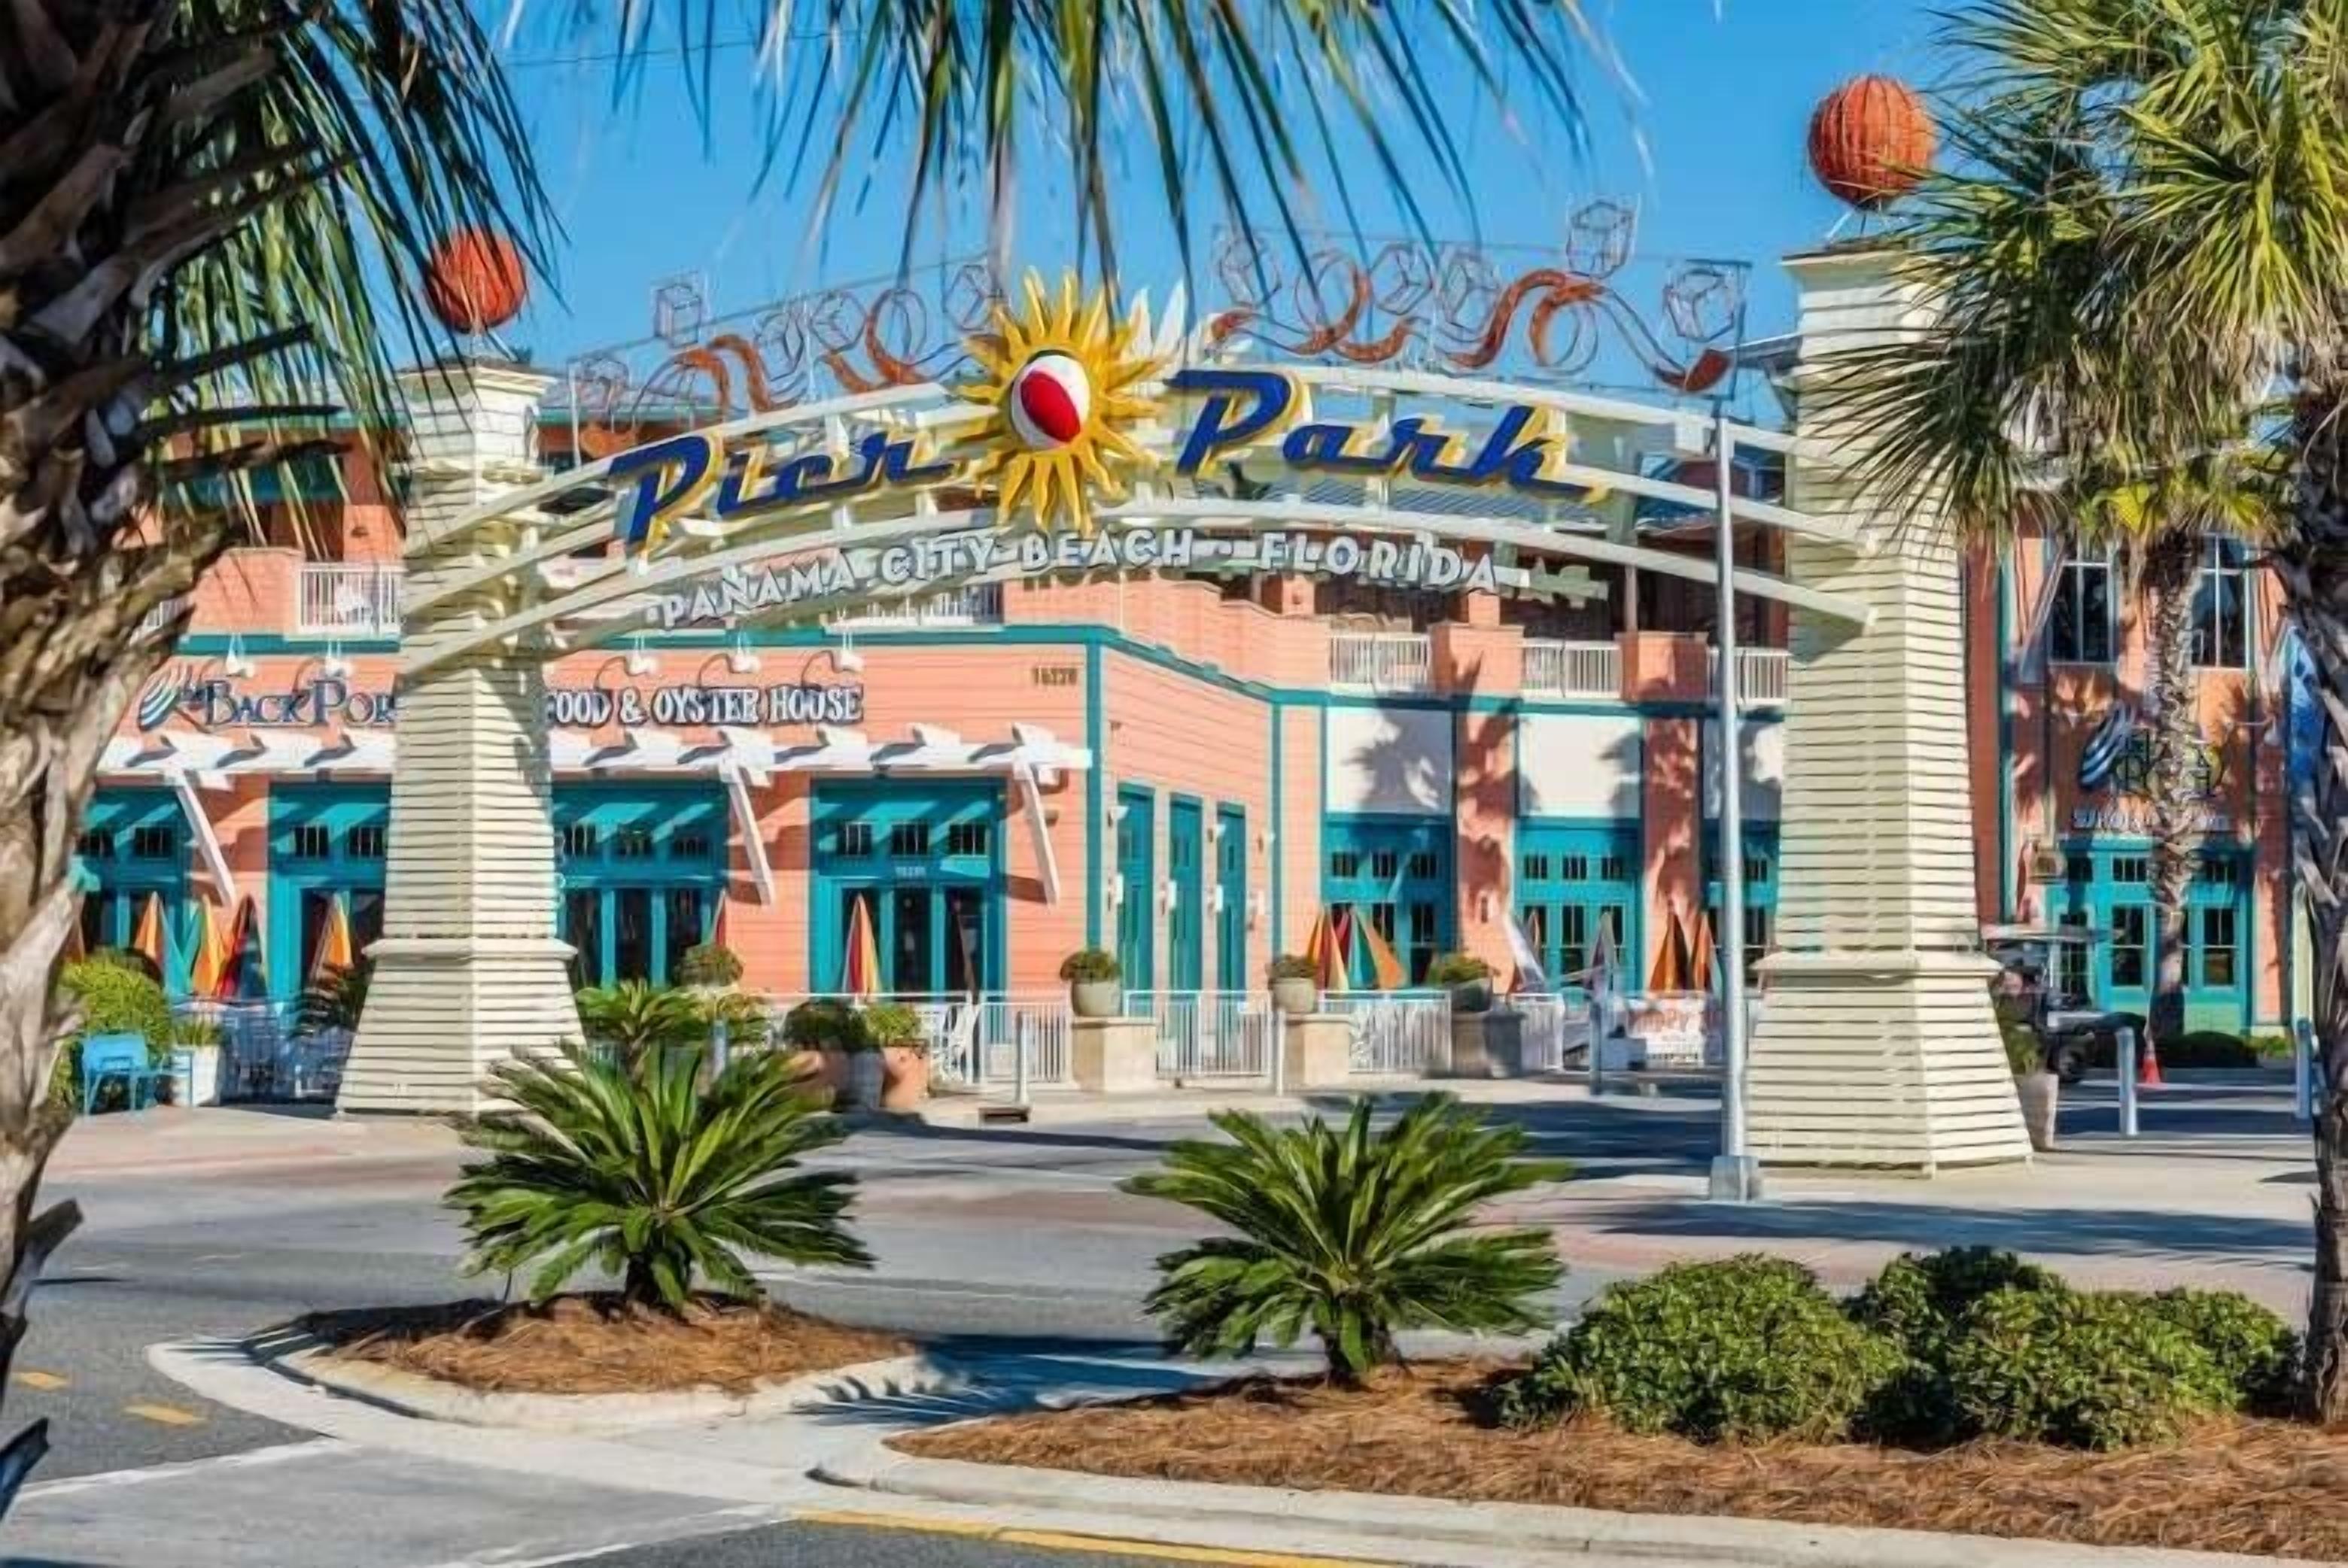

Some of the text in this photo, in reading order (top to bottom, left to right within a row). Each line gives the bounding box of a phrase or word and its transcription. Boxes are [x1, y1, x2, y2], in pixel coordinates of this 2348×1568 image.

[605, 369, 1608, 554] Pier Park
[662, 528, 1498, 630] PANAMA CITY BEACH FLORIDA
[204, 679, 315, 727] BACK
[309, 679, 395, 727] POR
[619, 686, 648, 726] &
[651, 685, 761, 727] OYSTER
[765, 684, 864, 726] HOUSE
